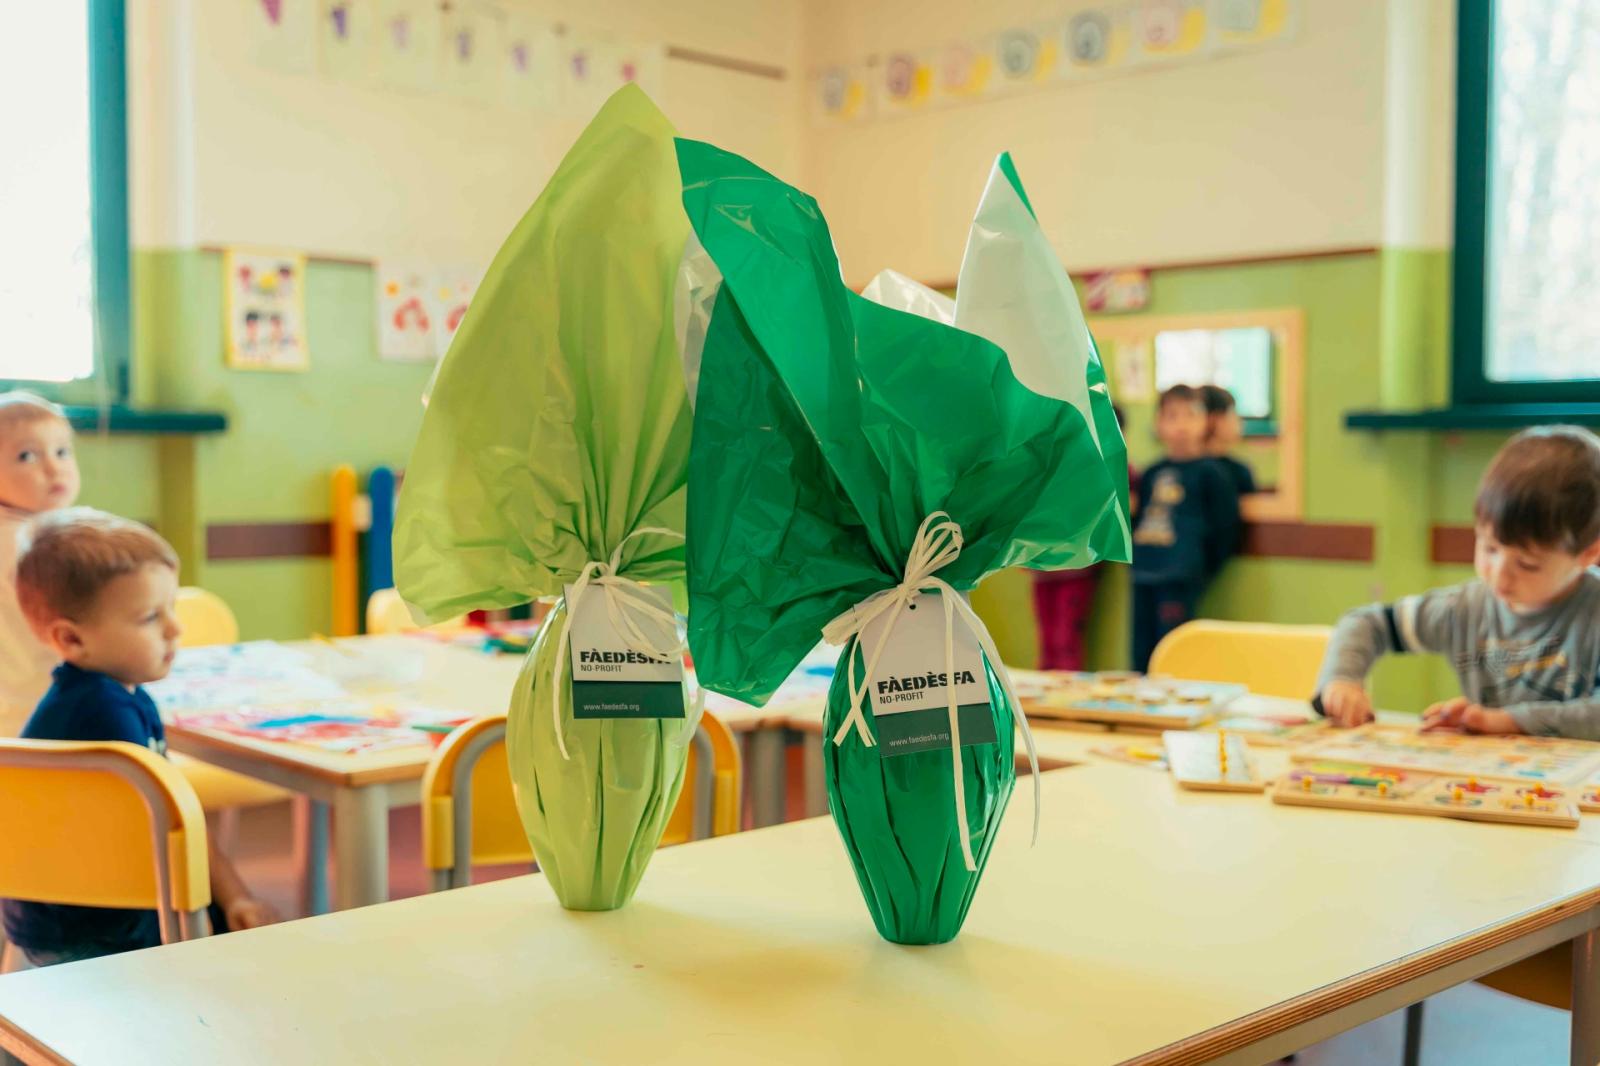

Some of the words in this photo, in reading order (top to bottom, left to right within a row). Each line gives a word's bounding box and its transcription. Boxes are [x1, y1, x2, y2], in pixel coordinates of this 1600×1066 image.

[580, 664, 622, 672] NO-PROFIT
[879, 691, 924, 704] NO-PROFIT
[889, 732, 950, 747] www.faedesfa.org
